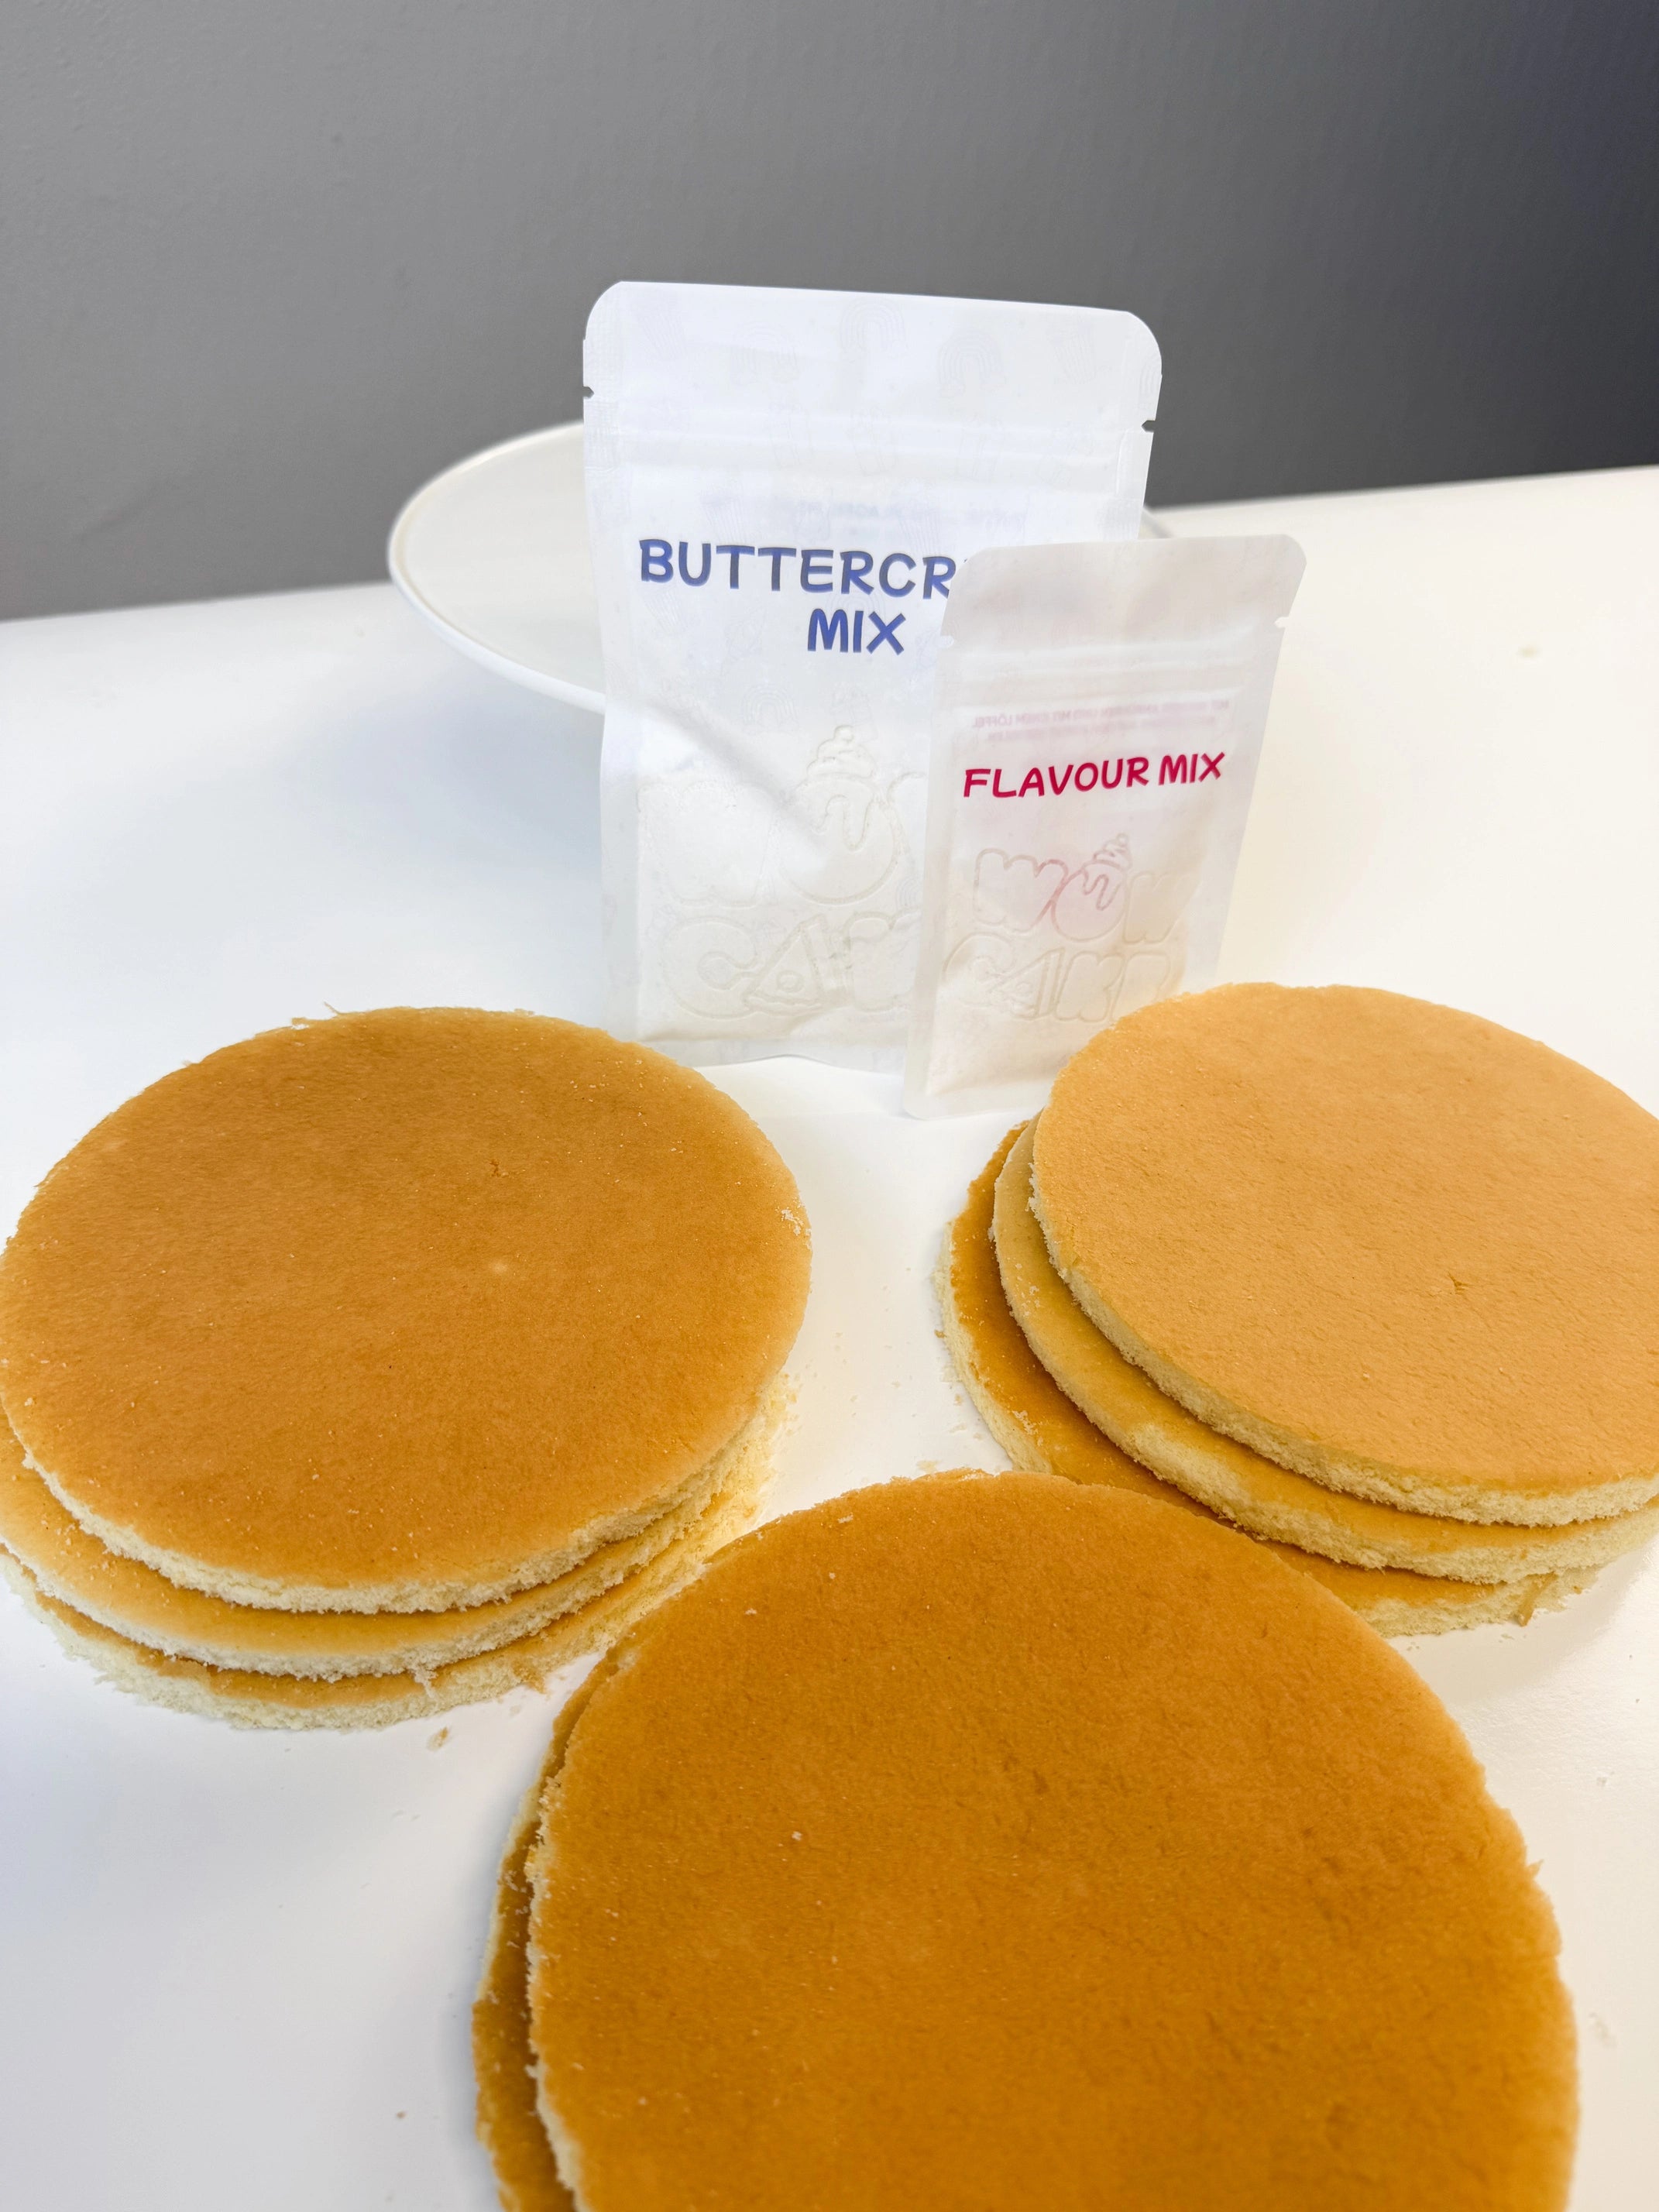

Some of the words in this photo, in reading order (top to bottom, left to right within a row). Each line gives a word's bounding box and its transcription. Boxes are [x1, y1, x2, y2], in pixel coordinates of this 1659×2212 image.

[639, 538, 967, 599] BUTTERCR
[807, 607, 906, 656] MIX
[963, 757, 1149, 799] FLAVOUR
[1159, 751, 1225, 785] MIX
